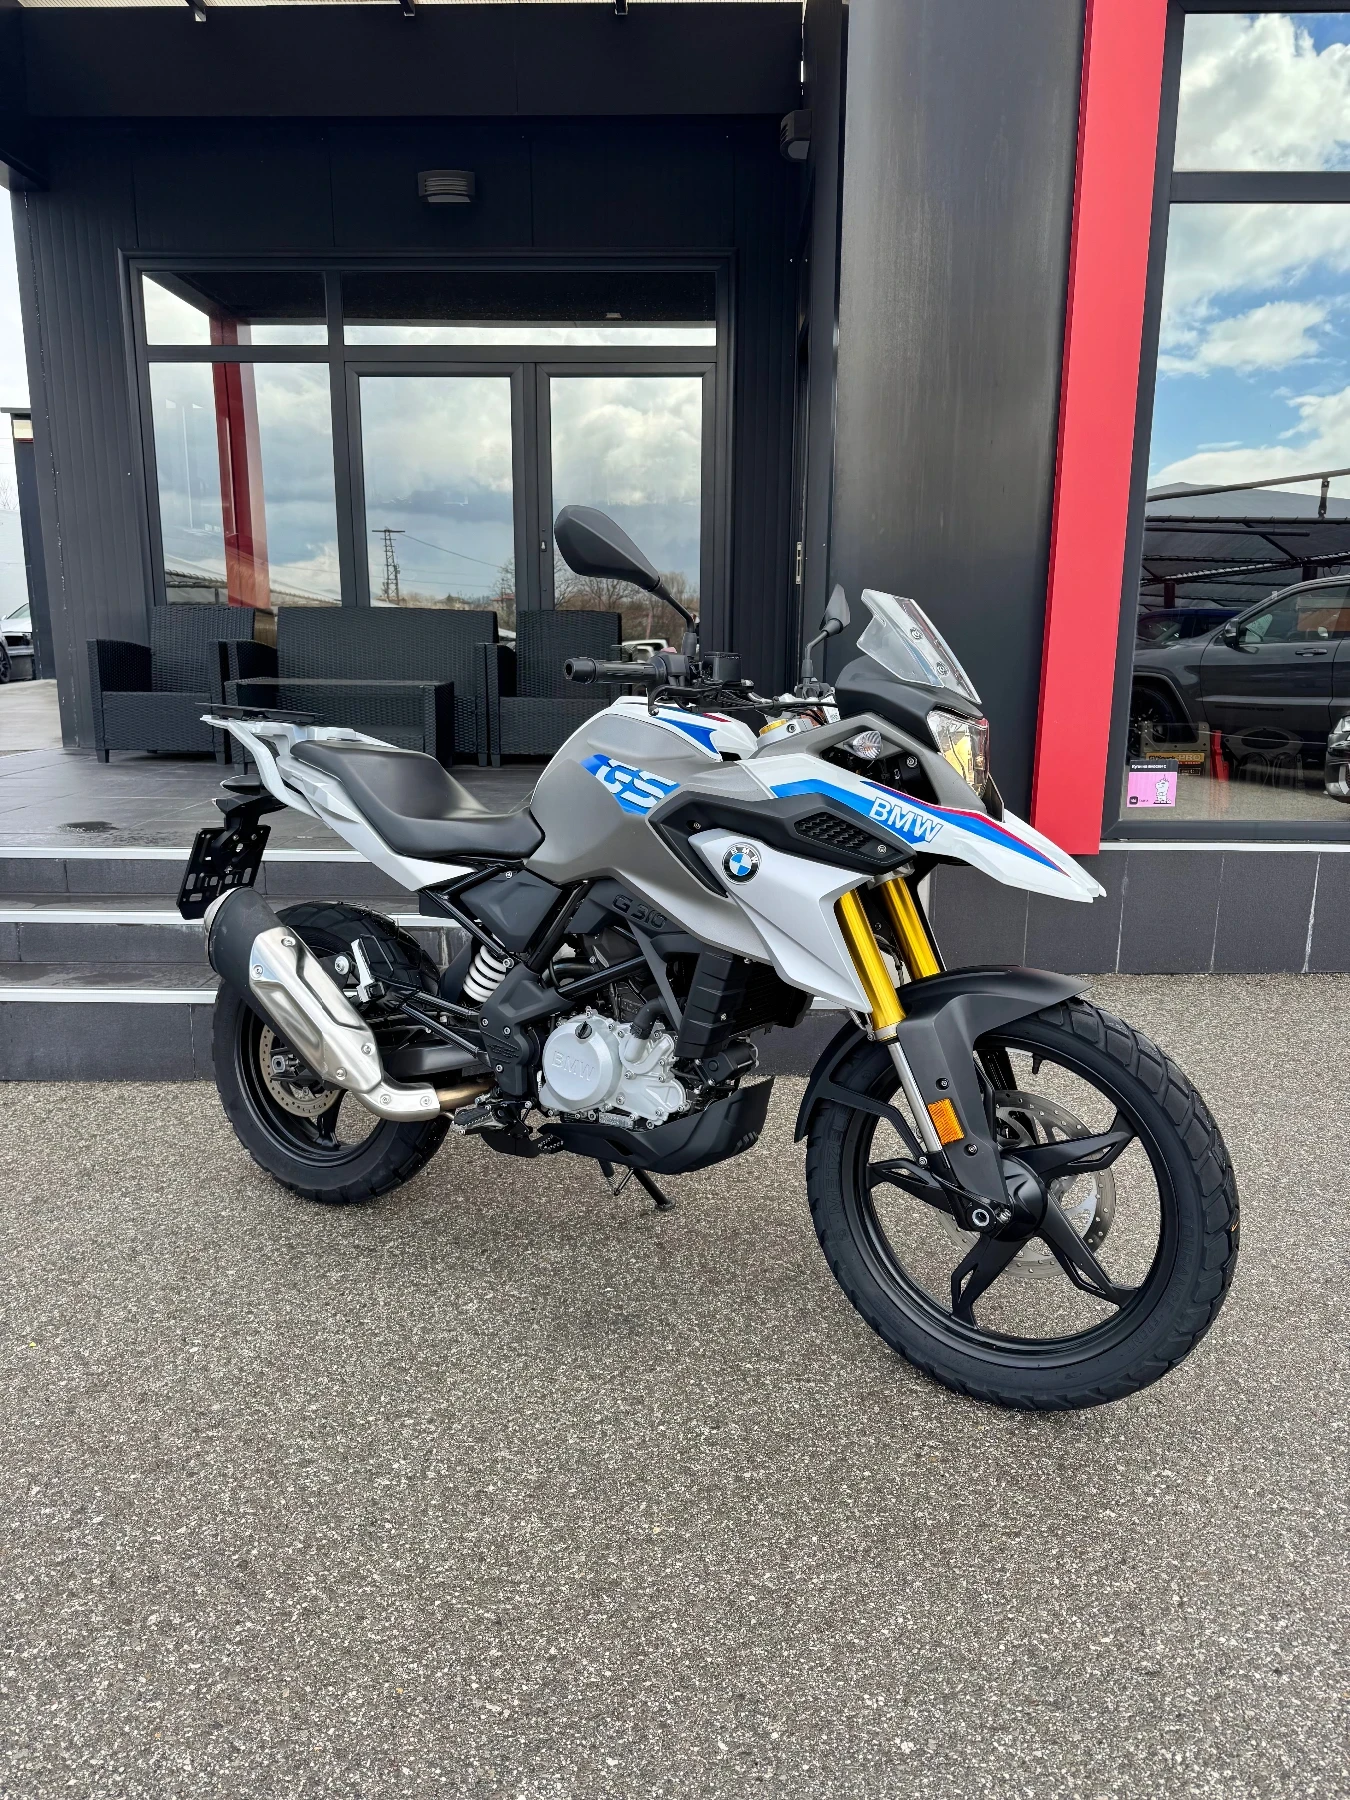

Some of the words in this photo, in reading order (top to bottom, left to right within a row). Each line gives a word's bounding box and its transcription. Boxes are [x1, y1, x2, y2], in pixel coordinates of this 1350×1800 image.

[595, 759, 678, 809] GS
[869, 797, 944, 843] BMW
[612, 894, 633, 914] G
[631, 903, 667, 929] 310
[552, 1050, 595, 1082] BMW
